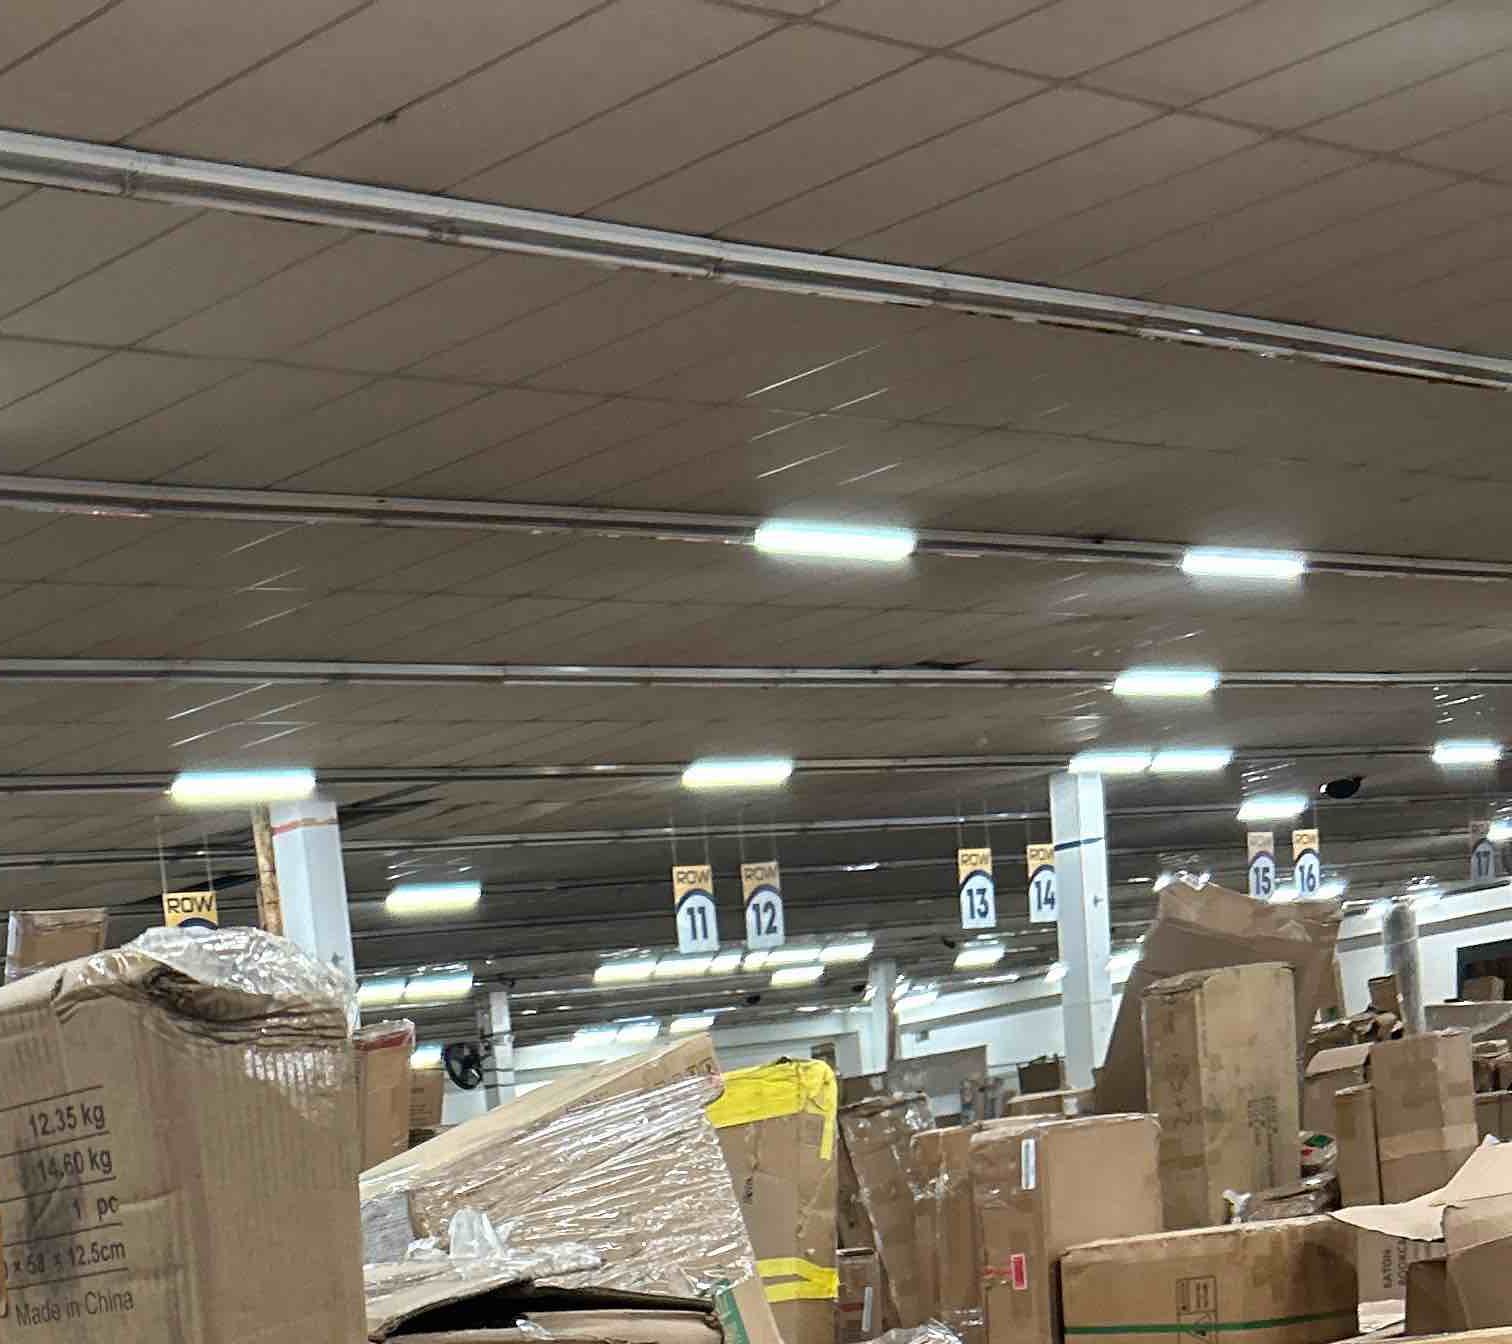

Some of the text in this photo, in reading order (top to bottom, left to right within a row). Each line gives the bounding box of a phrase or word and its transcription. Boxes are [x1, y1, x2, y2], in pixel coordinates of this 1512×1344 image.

[1254, 865, 1271, 895] 15
[1299, 863, 1316, 893] 16
[167, 895, 214, 914] ROW
[966, 887, 990, 920] 13
[1034, 879, 1056, 912] 14
[685, 906, 709, 941] 11
[751, 900, 778, 937] 12
[29, 1103, 107, 1138] 12.35 kg
[88, 1148, 113, 1176] kg
[97, 1194, 120, 1221] pc
[15, 1289, 137, 1329] Made in China
